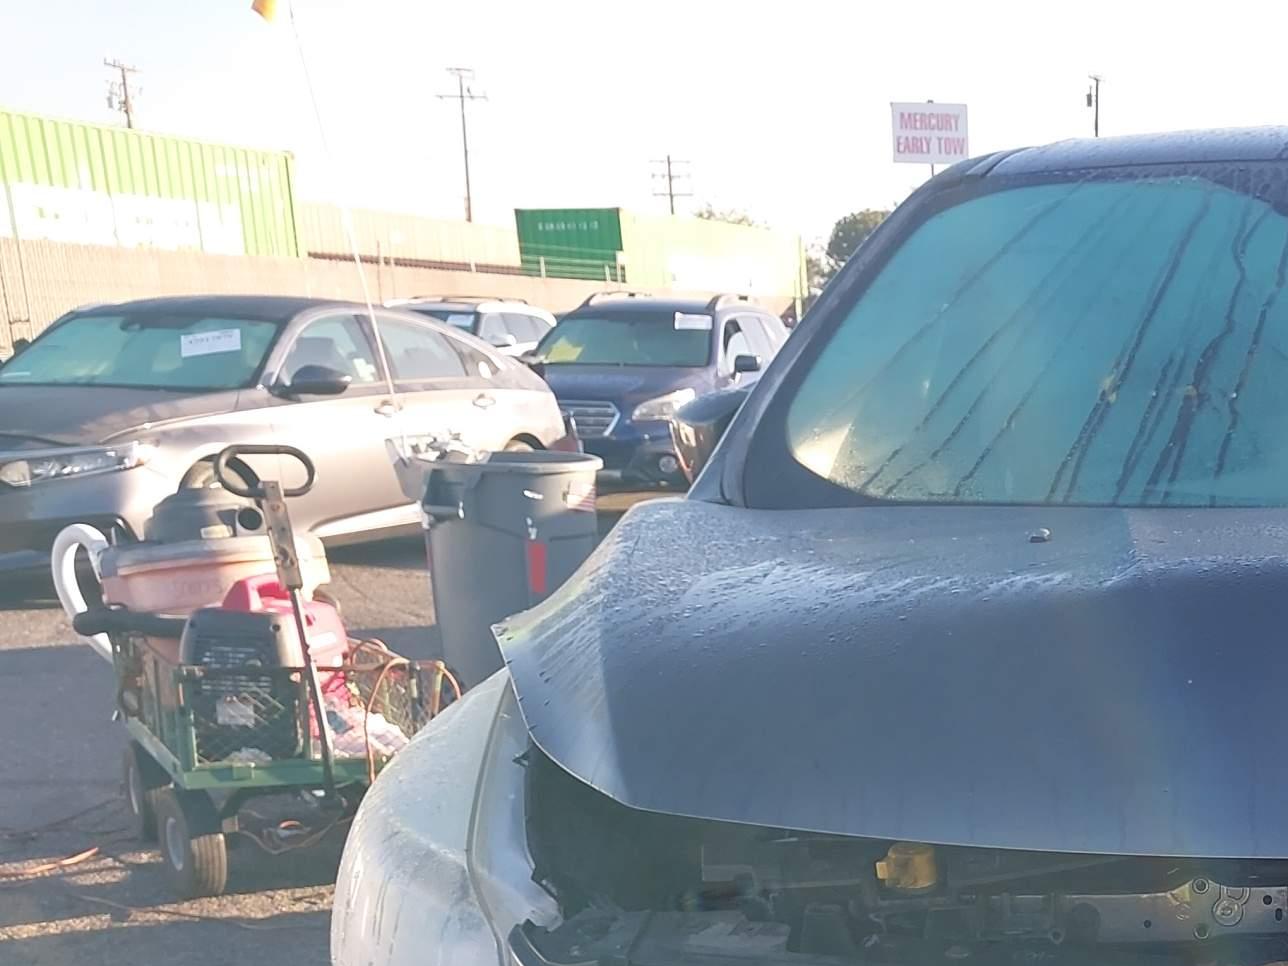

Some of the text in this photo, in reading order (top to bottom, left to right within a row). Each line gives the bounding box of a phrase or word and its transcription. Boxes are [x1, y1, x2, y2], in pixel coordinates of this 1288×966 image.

[899, 112, 960, 131] MERCURY
[896, 136, 965, 155] EARLY TOW
